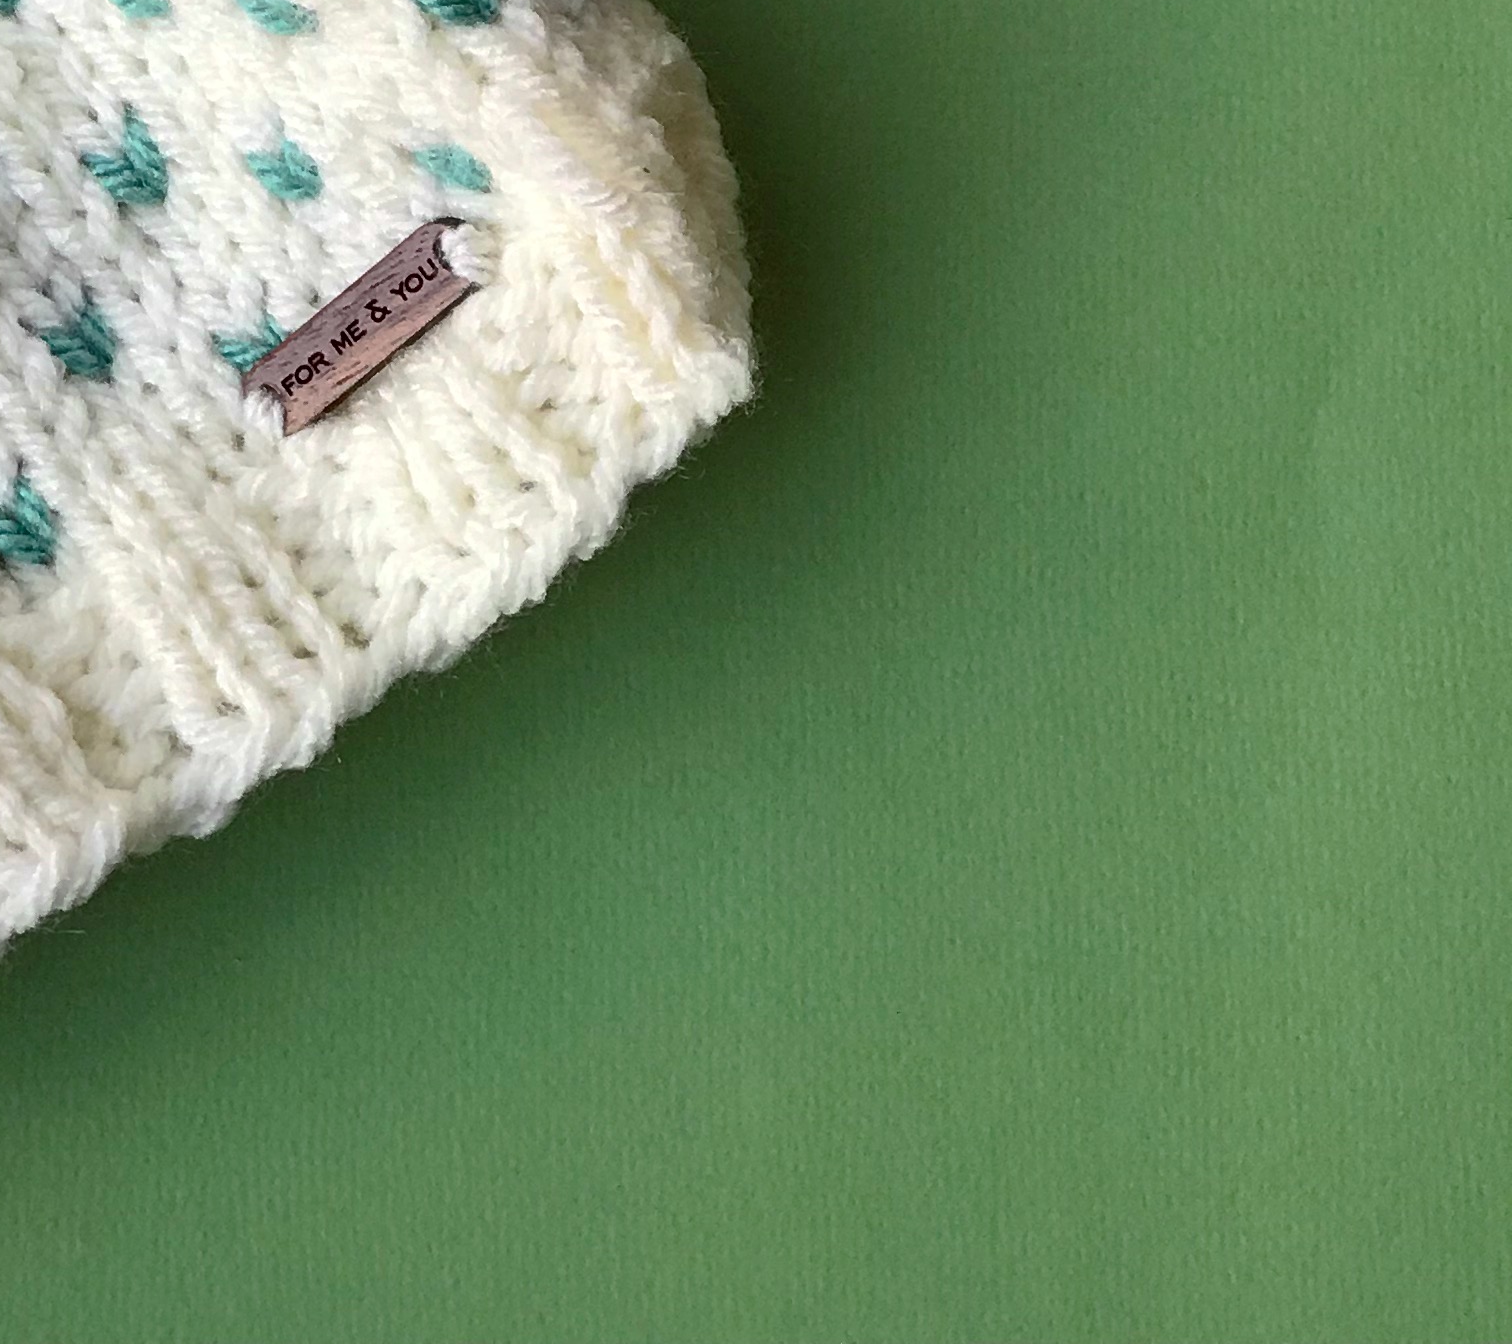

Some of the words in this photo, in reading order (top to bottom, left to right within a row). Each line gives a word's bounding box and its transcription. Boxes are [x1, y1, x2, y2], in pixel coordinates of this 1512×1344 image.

[281, 351, 331, 396] FOR
[331, 319, 367, 355] ME
[364, 298, 392, 323] &
[390, 258, 439, 301] YOU
